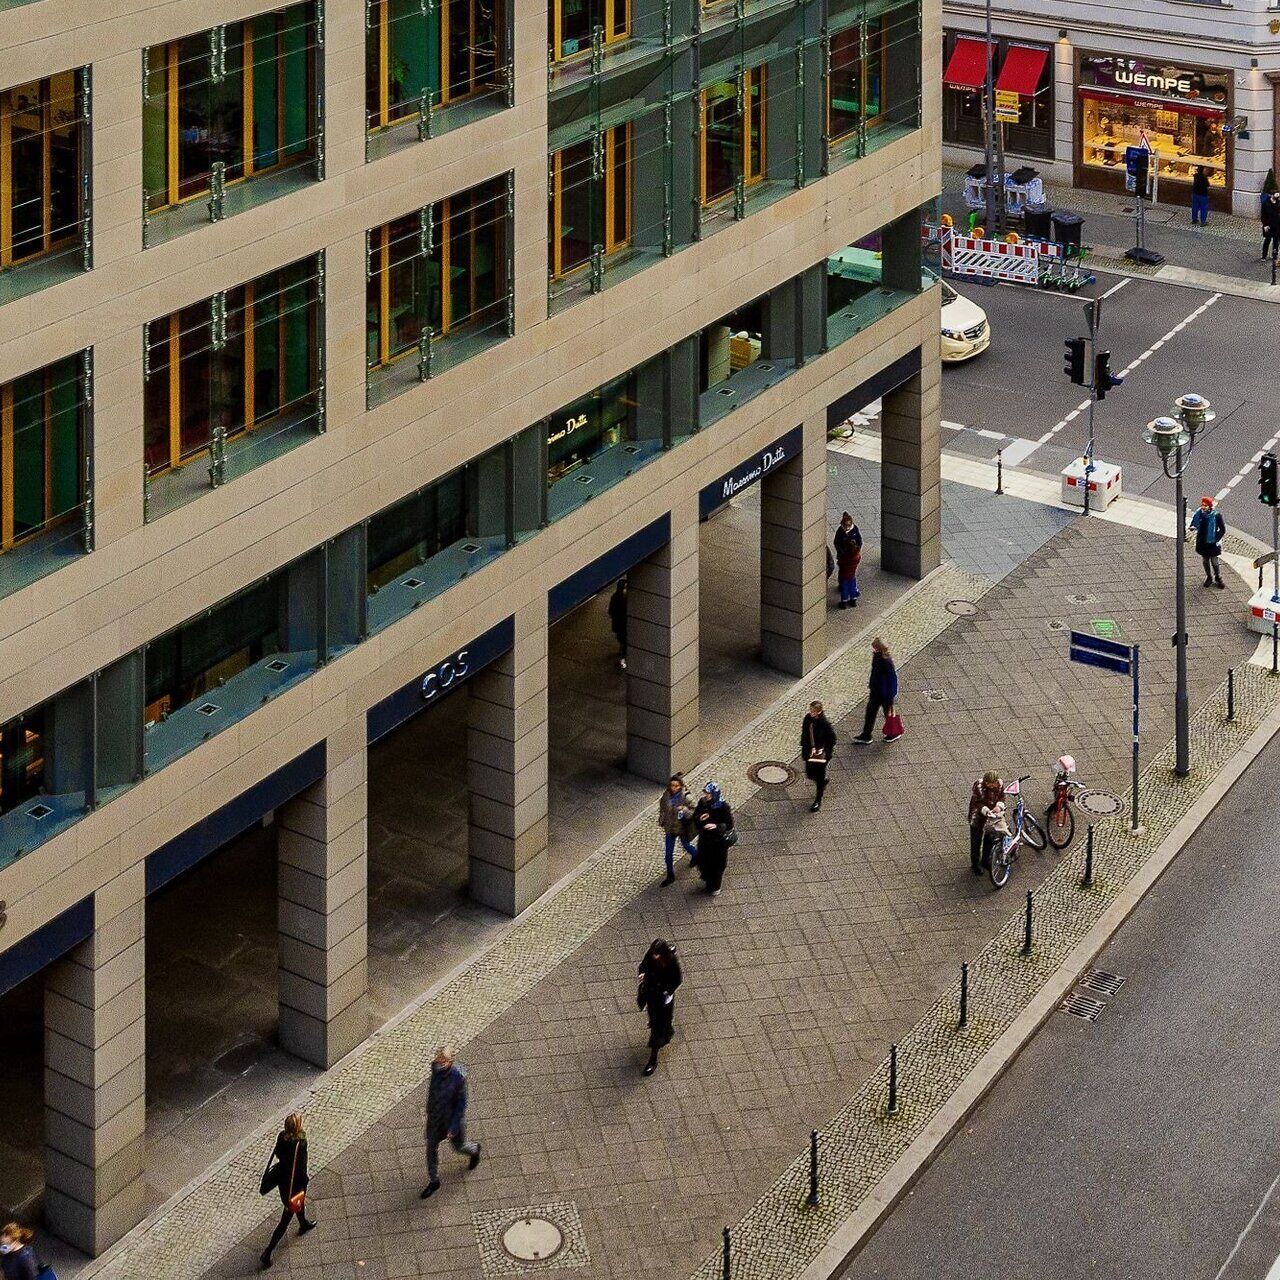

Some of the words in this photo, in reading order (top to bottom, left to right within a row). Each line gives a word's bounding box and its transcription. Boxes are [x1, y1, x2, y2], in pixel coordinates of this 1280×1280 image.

[1115, 70, 1191, 93] WEMPE
[1134, 100, 1164, 110] WEMPE
[422, 651, 469, 698] COS
